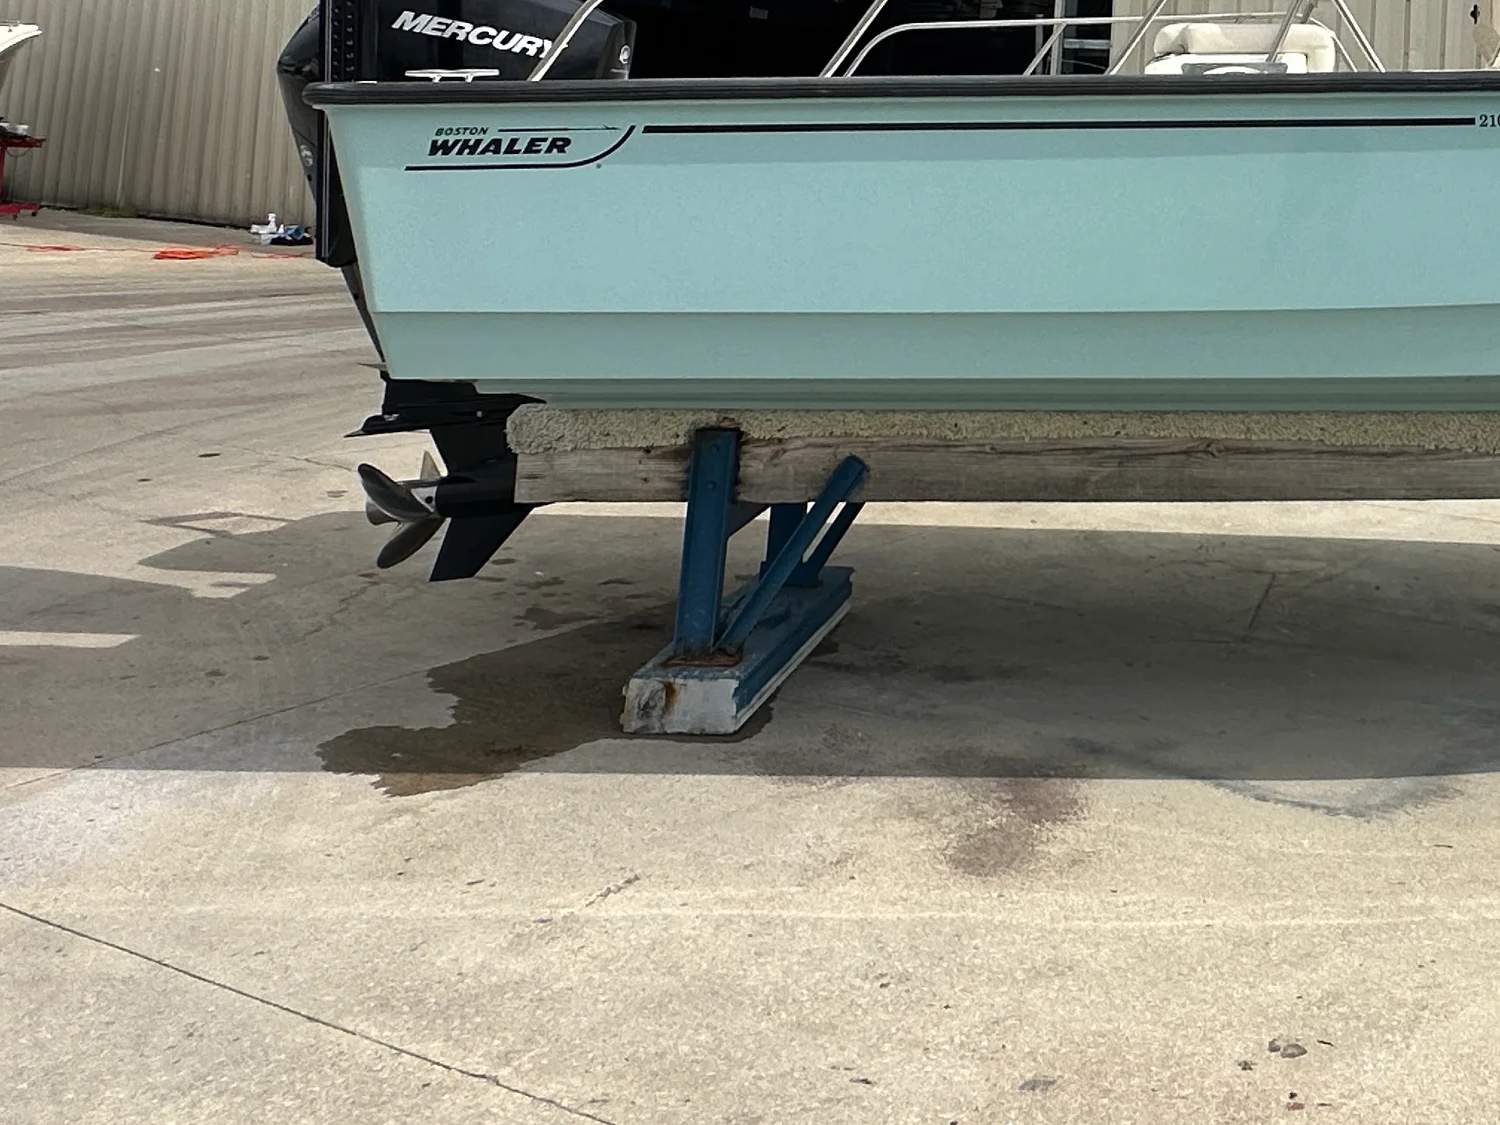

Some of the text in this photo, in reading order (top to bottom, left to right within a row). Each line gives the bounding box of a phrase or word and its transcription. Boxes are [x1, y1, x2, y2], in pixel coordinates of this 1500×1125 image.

[391, 10, 568, 59] MERCURY
[435, 126, 489, 137] BOSTON
[428, 137, 572, 157] WHALER
